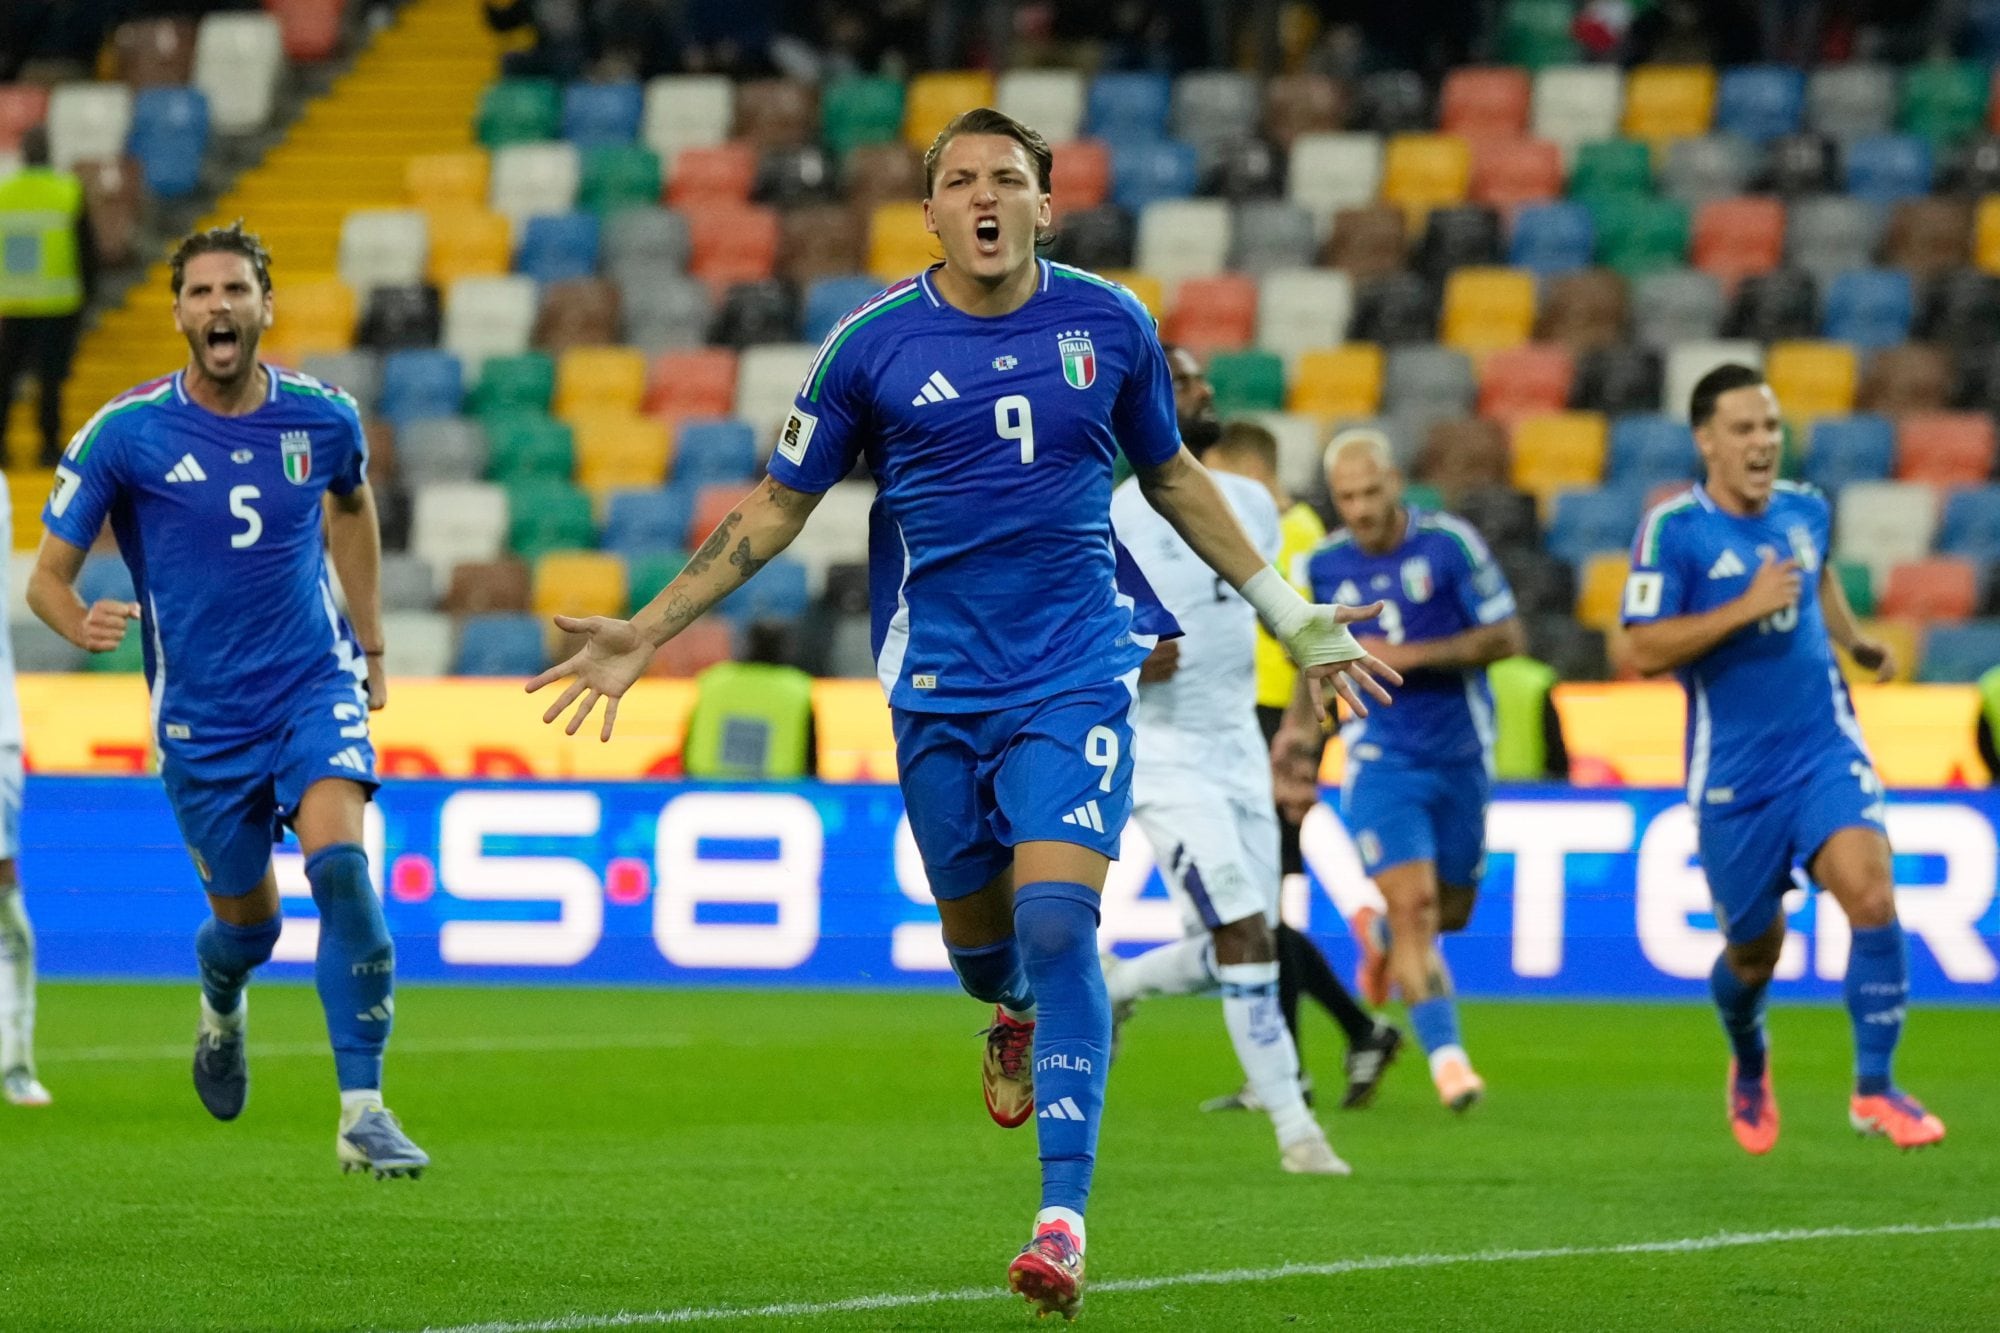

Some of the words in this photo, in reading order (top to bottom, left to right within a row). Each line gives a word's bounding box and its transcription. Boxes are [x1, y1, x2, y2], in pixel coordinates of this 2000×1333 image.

[1062, 342, 1091, 353] ITALIA
[995, 394, 1034, 464] 9
[229, 484, 263, 548] 5
[1085, 725, 1118, 793] 9
[1037, 1054, 1091, 1075] ITALIA
